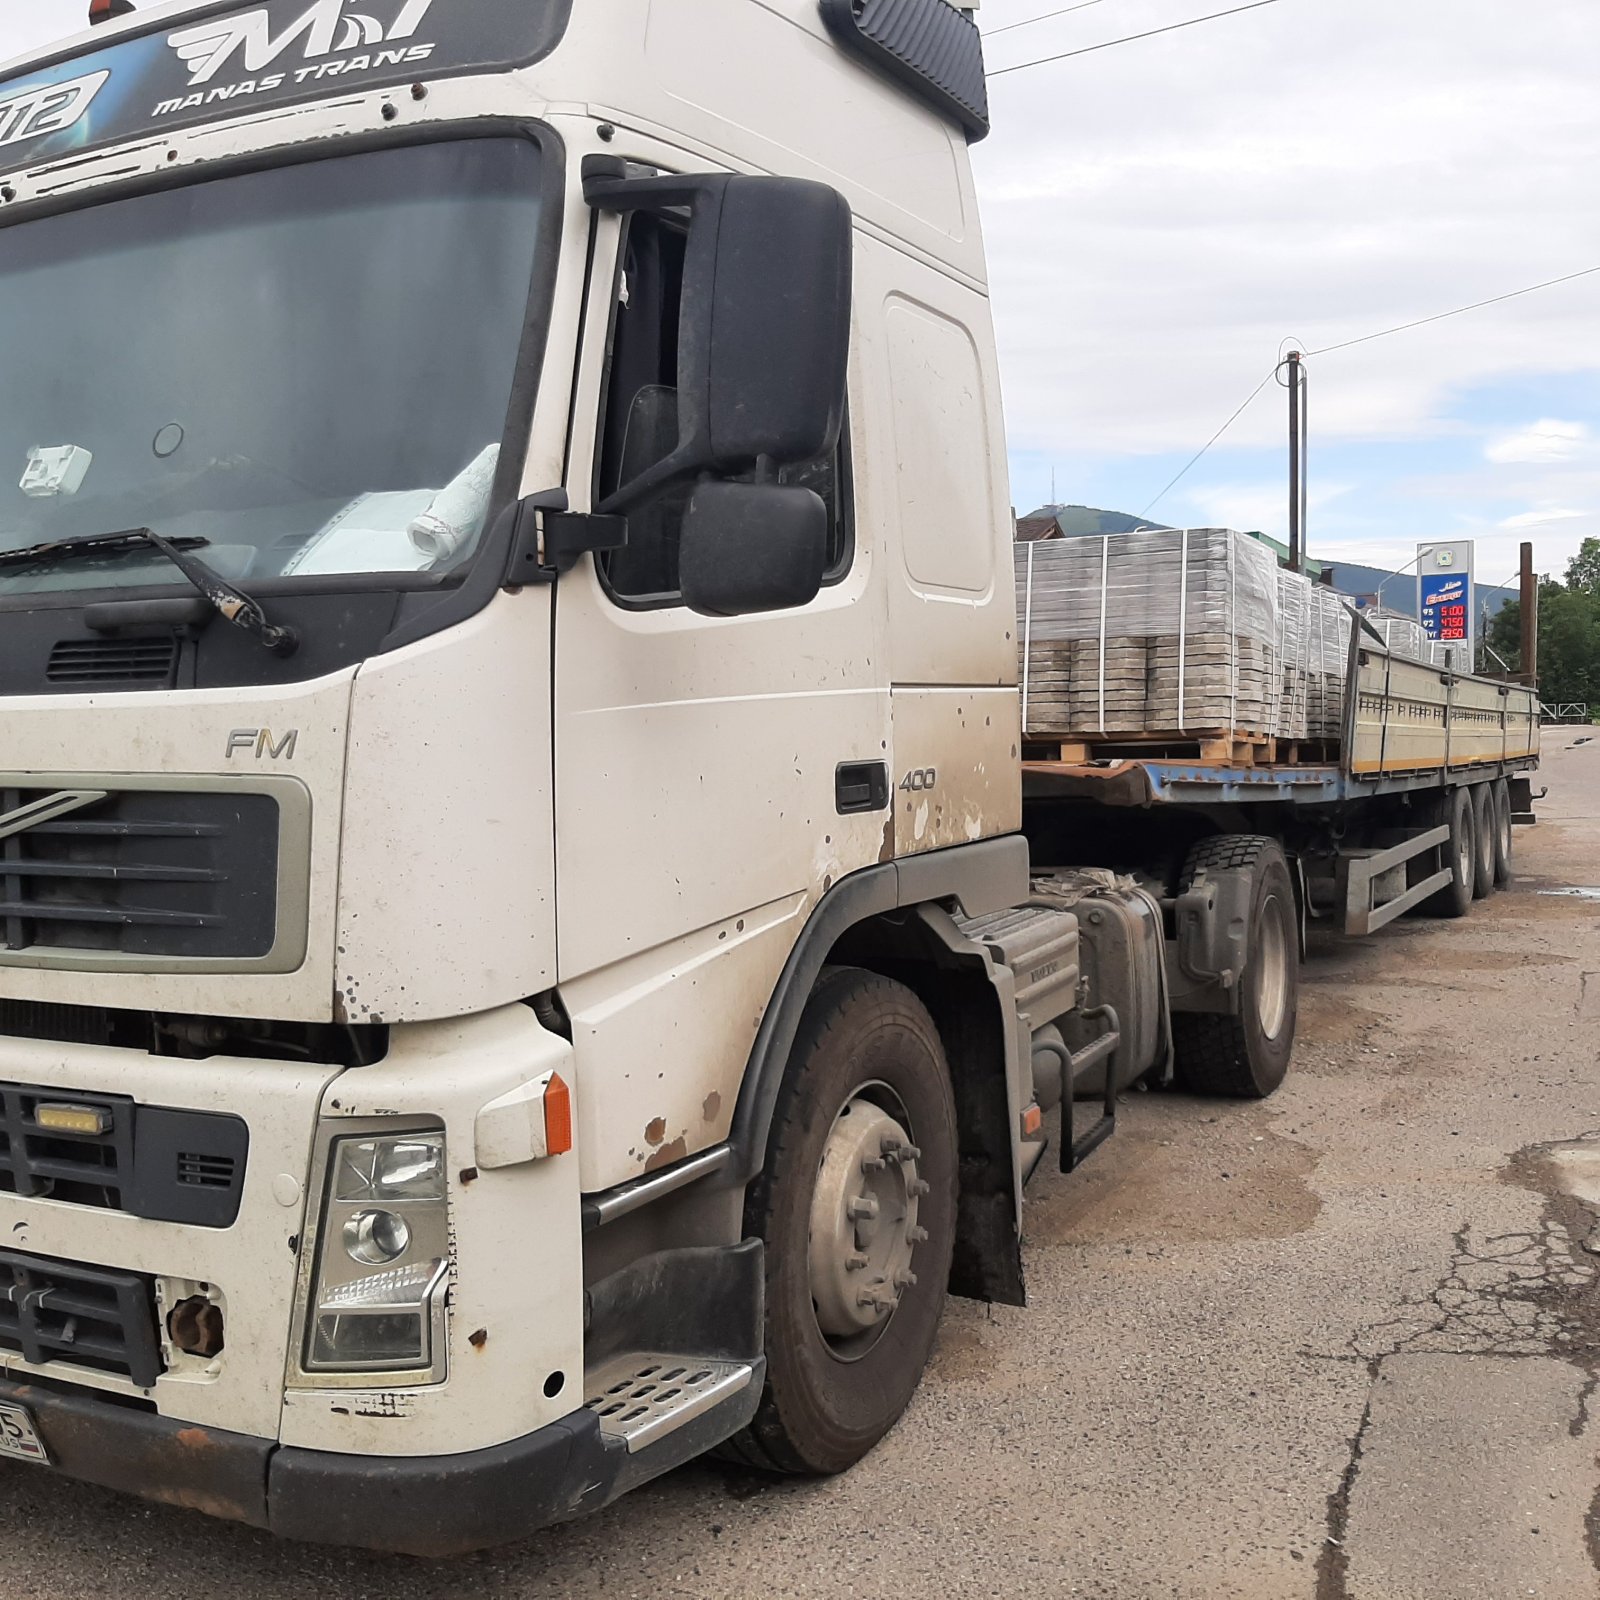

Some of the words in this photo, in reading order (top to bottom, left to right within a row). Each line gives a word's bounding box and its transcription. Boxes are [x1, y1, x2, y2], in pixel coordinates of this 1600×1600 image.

[151, 72, 287, 117] MANAS
[294, 43, 436, 83] TRANS
[1422, 608, 1434, 616] 95
[1422, 619, 1434, 627] 92
[225, 728, 298, 760] FM
[898, 767, 936, 792] 400
